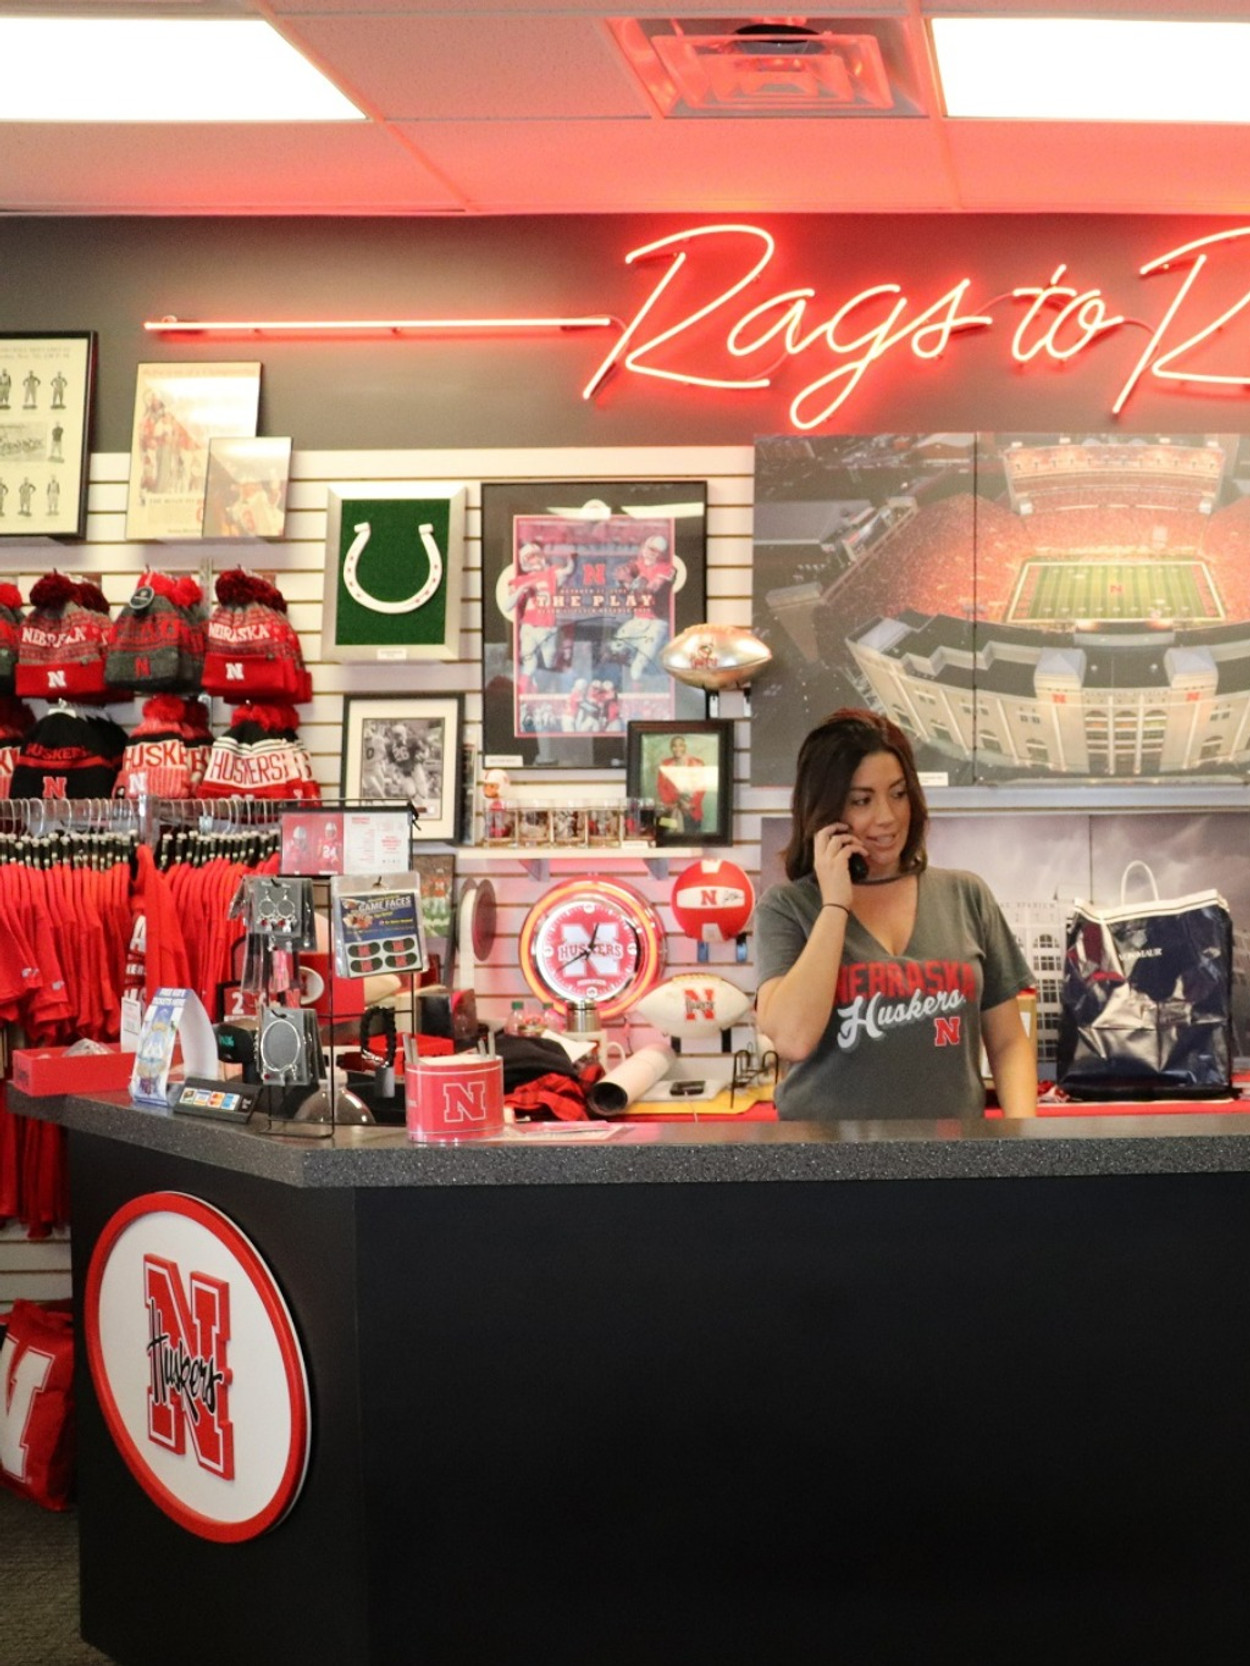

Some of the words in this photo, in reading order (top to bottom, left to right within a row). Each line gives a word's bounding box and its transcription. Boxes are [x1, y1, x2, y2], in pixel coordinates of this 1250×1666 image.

[583, 224, 992, 430] Rags
[1012, 263, 1125, 361] to
[582, 563, 607, 586] N
[536, 595, 581, 607] THE
[593, 594, 653, 607] PLAY
[134, 656, 151, 678] N
[224, 662, 244, 681] N
[47, 670, 67, 689] N
[42, 775, 67, 799] N
[128, 771, 148, 794] N
[701, 890, 717, 906] N
[684, 989, 715, 1020] N
[837, 988, 966, 1050] Huskers
[934, 1016, 961, 1047] N
[442, 1080, 487, 1123] N
[143, 1252, 235, 1482] N
[146, 1299, 223, 1425] Huskers
